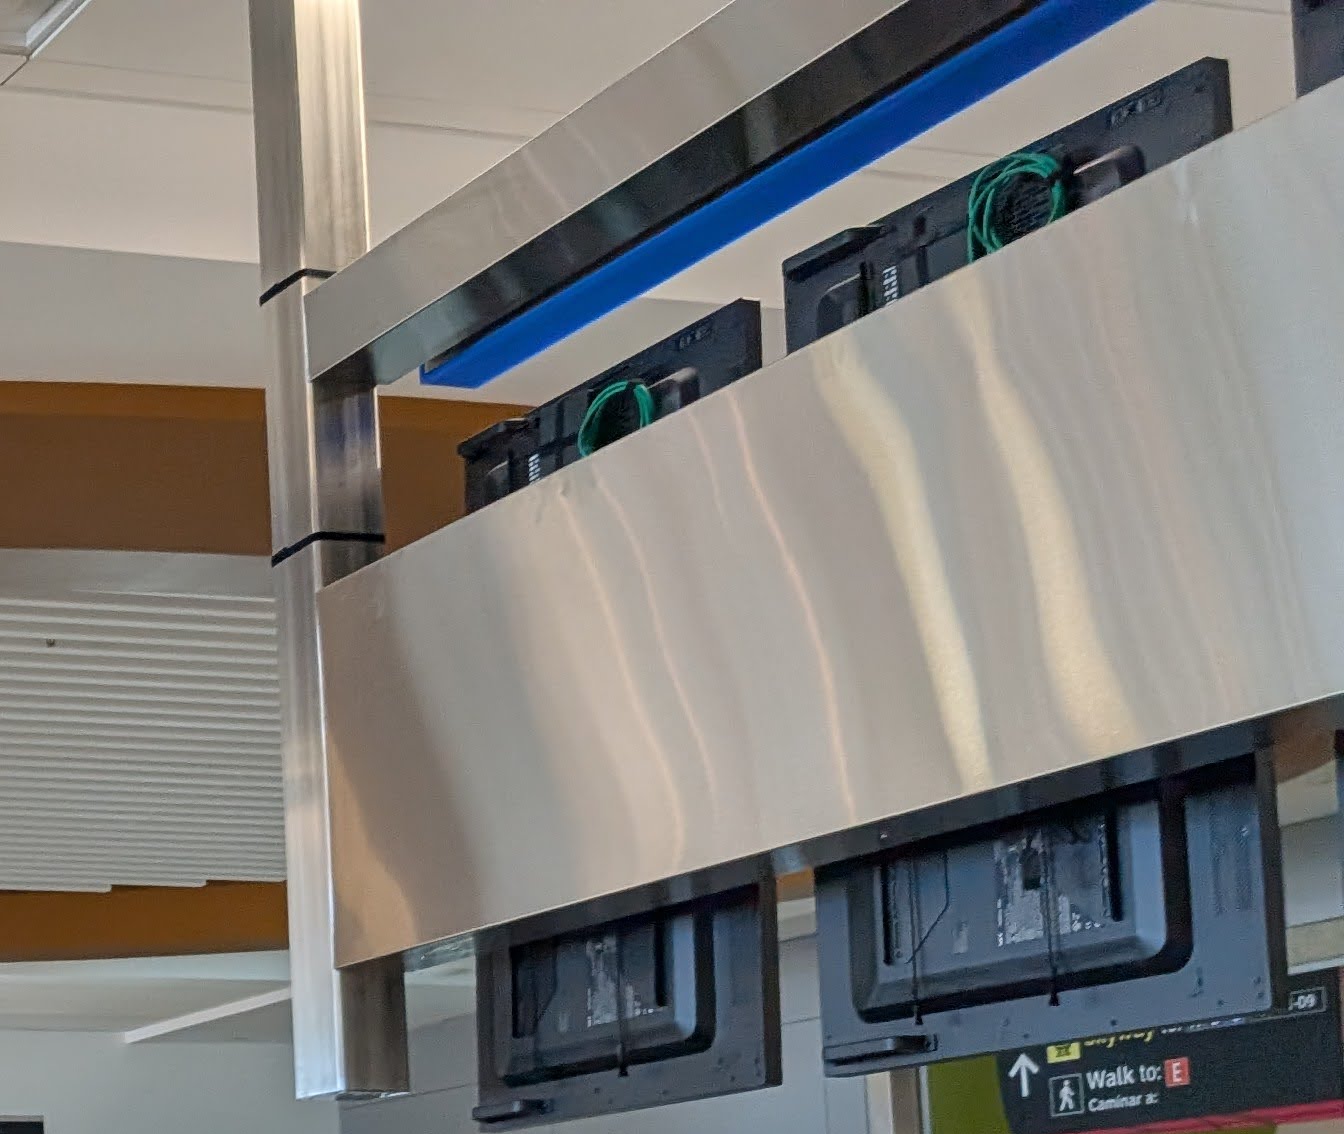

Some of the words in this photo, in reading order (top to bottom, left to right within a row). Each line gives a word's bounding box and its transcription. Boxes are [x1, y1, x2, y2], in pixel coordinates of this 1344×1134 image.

[1085, 1065, 1135, 1090] Walk
[1139, 1064, 1161, 1083] to:
[1171, 1061, 1182, 1083] E
[1087, 1093, 1143, 1112] Caminar
